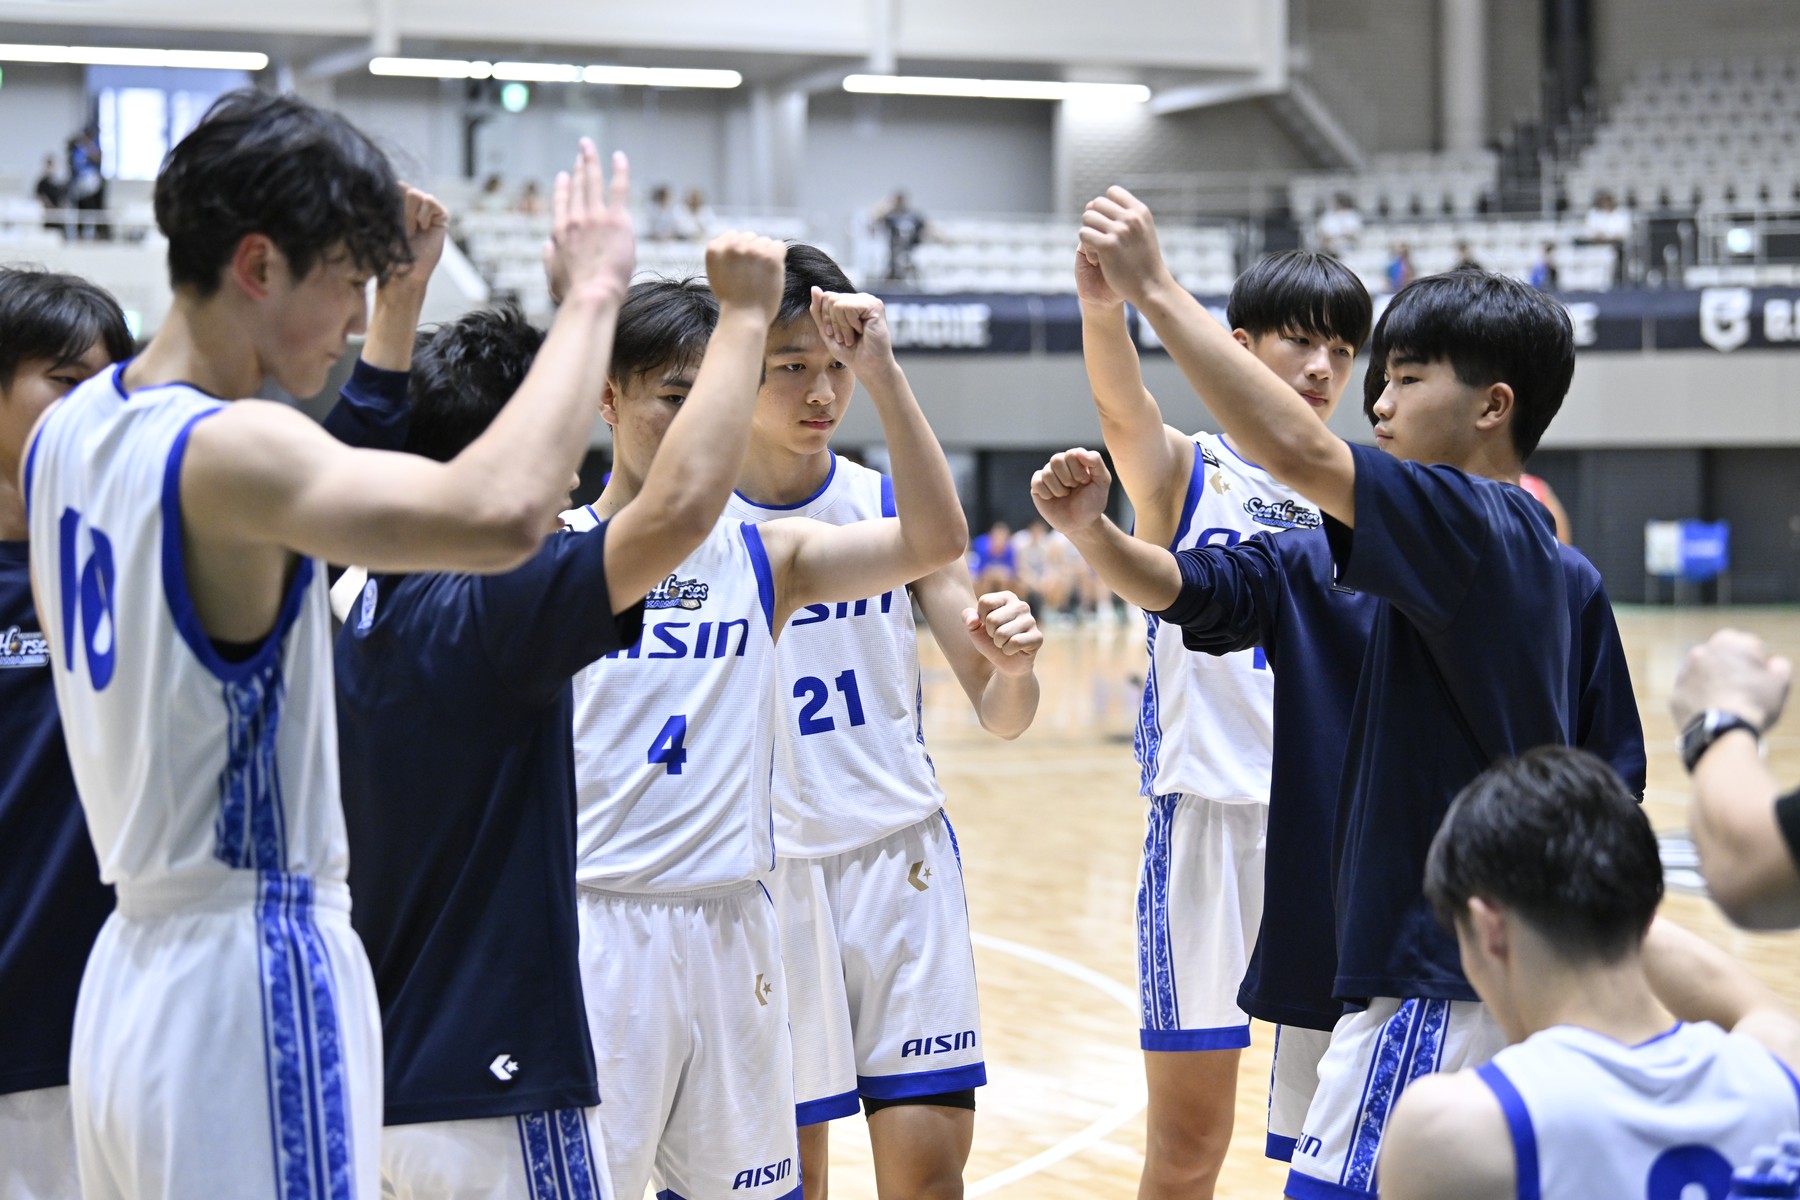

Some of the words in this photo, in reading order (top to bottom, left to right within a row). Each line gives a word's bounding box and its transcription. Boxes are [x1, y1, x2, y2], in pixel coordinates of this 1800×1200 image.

[645, 575, 708, 600] Horses
[645, 599, 682, 609] KAWA
[792, 669, 866, 736] 21
[647, 714, 687, 775] 4
[901, 1030, 976, 1058] AISIN
[732, 1157, 791, 1190] AISIN
